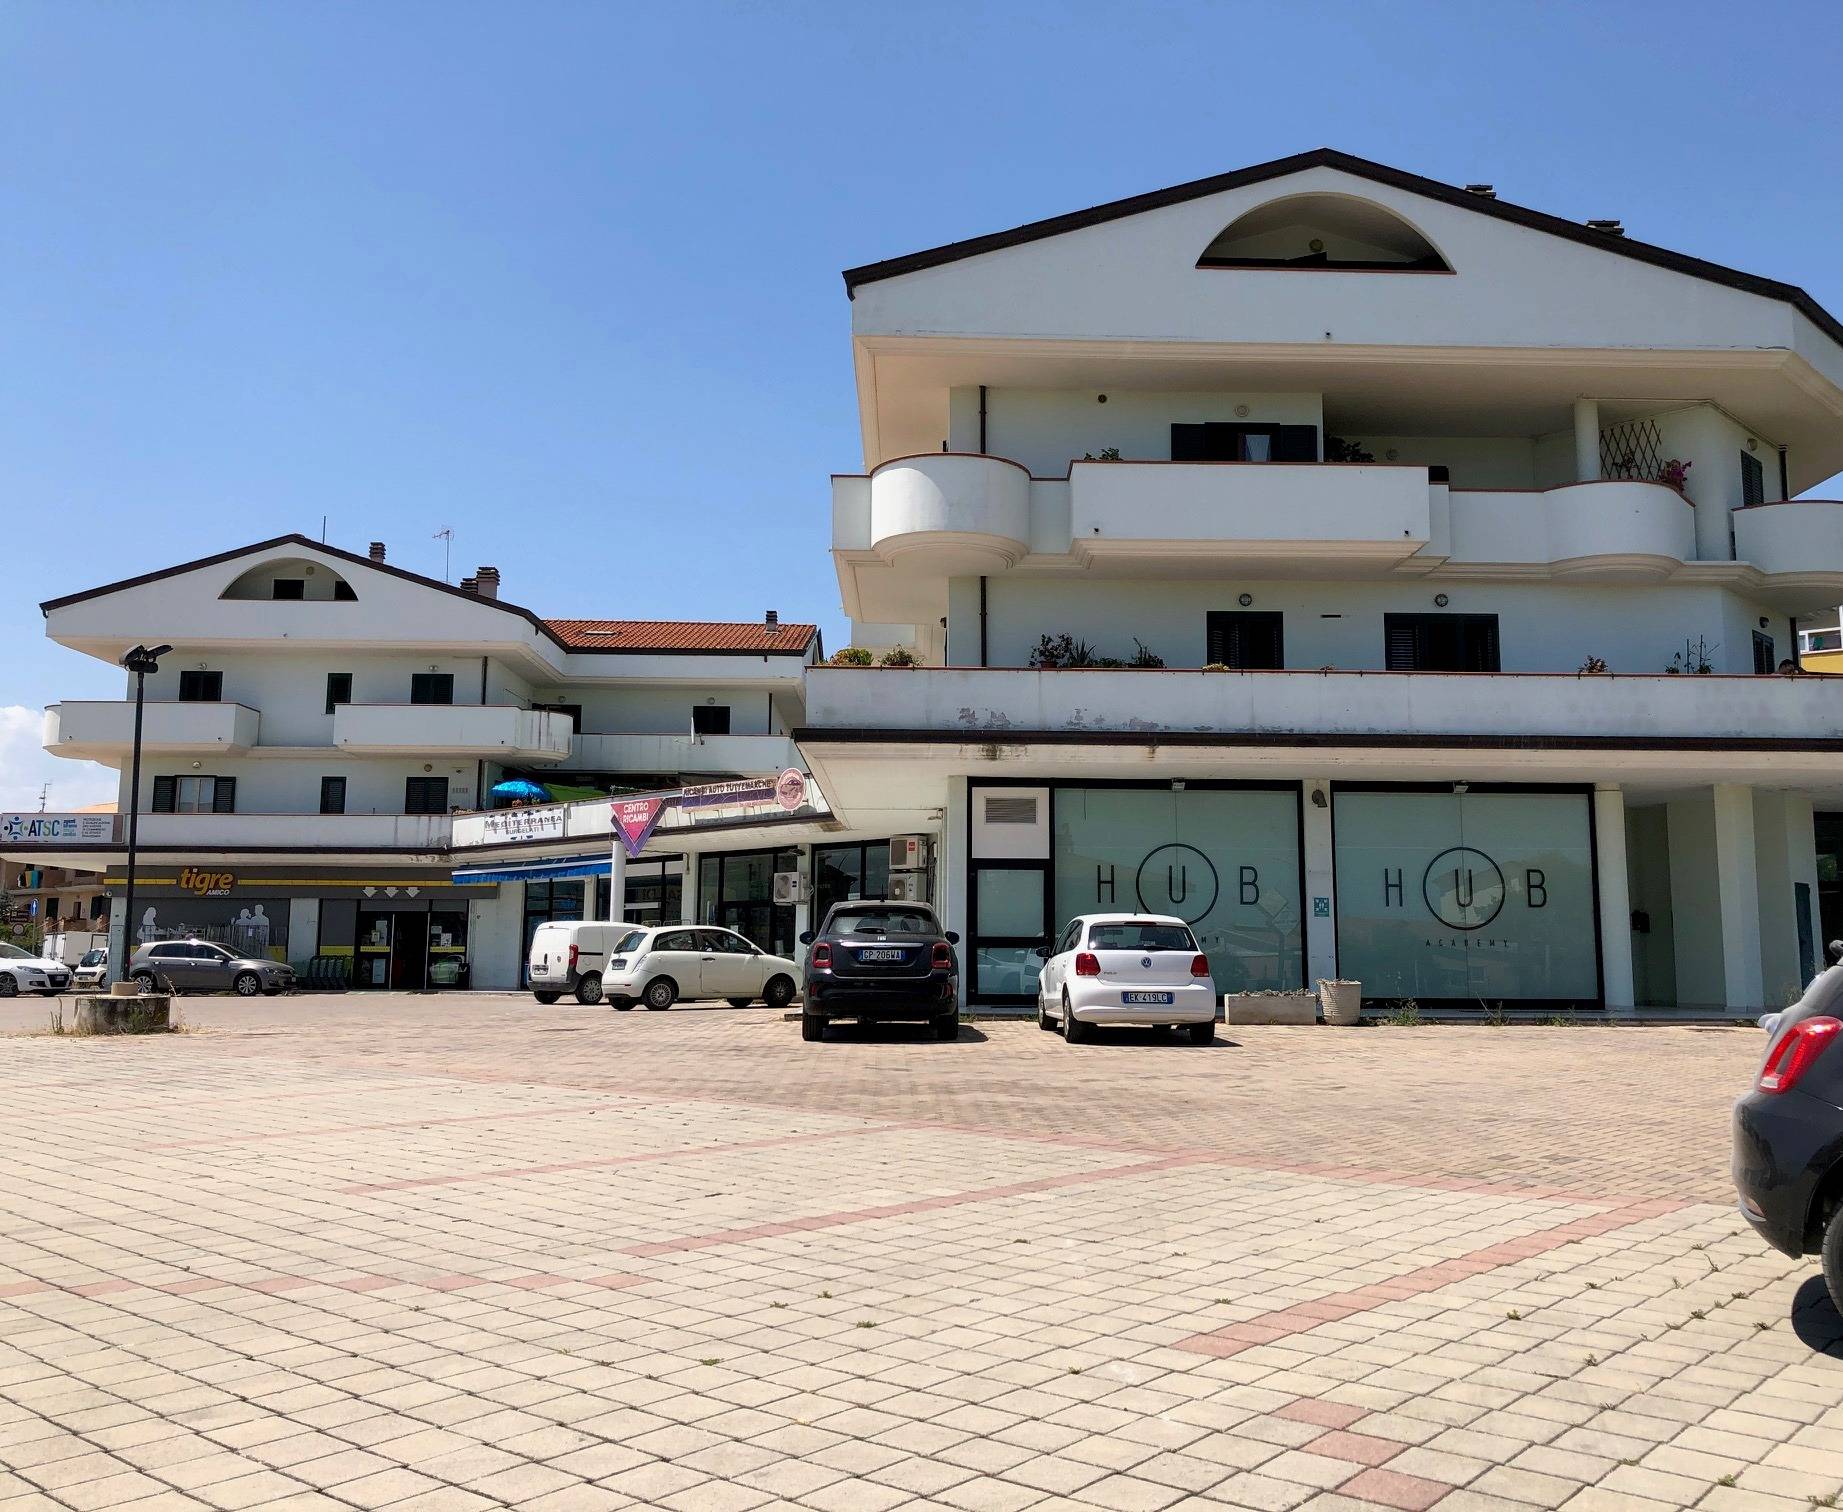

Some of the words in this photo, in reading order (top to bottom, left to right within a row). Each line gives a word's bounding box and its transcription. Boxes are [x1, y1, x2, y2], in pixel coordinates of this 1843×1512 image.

[709, 784, 725, 793] AUTO
[623, 801, 649, 814] CENTRO
[485, 815, 562, 829] MEDITERRANEA
[622, 812, 649, 823] RICAMBI
[28, 819, 60, 837] ATSC
[181, 868, 234, 895] tigre
[1097, 864, 1260, 906] HUB
[1385, 868, 1547, 908] HUB
[1425, 938, 1509, 948] ACADEMY
[863, 950, 874, 959] GP
[1129, 993, 1140, 1002] EK
[1142, 993, 1168, 1002] 419LC
